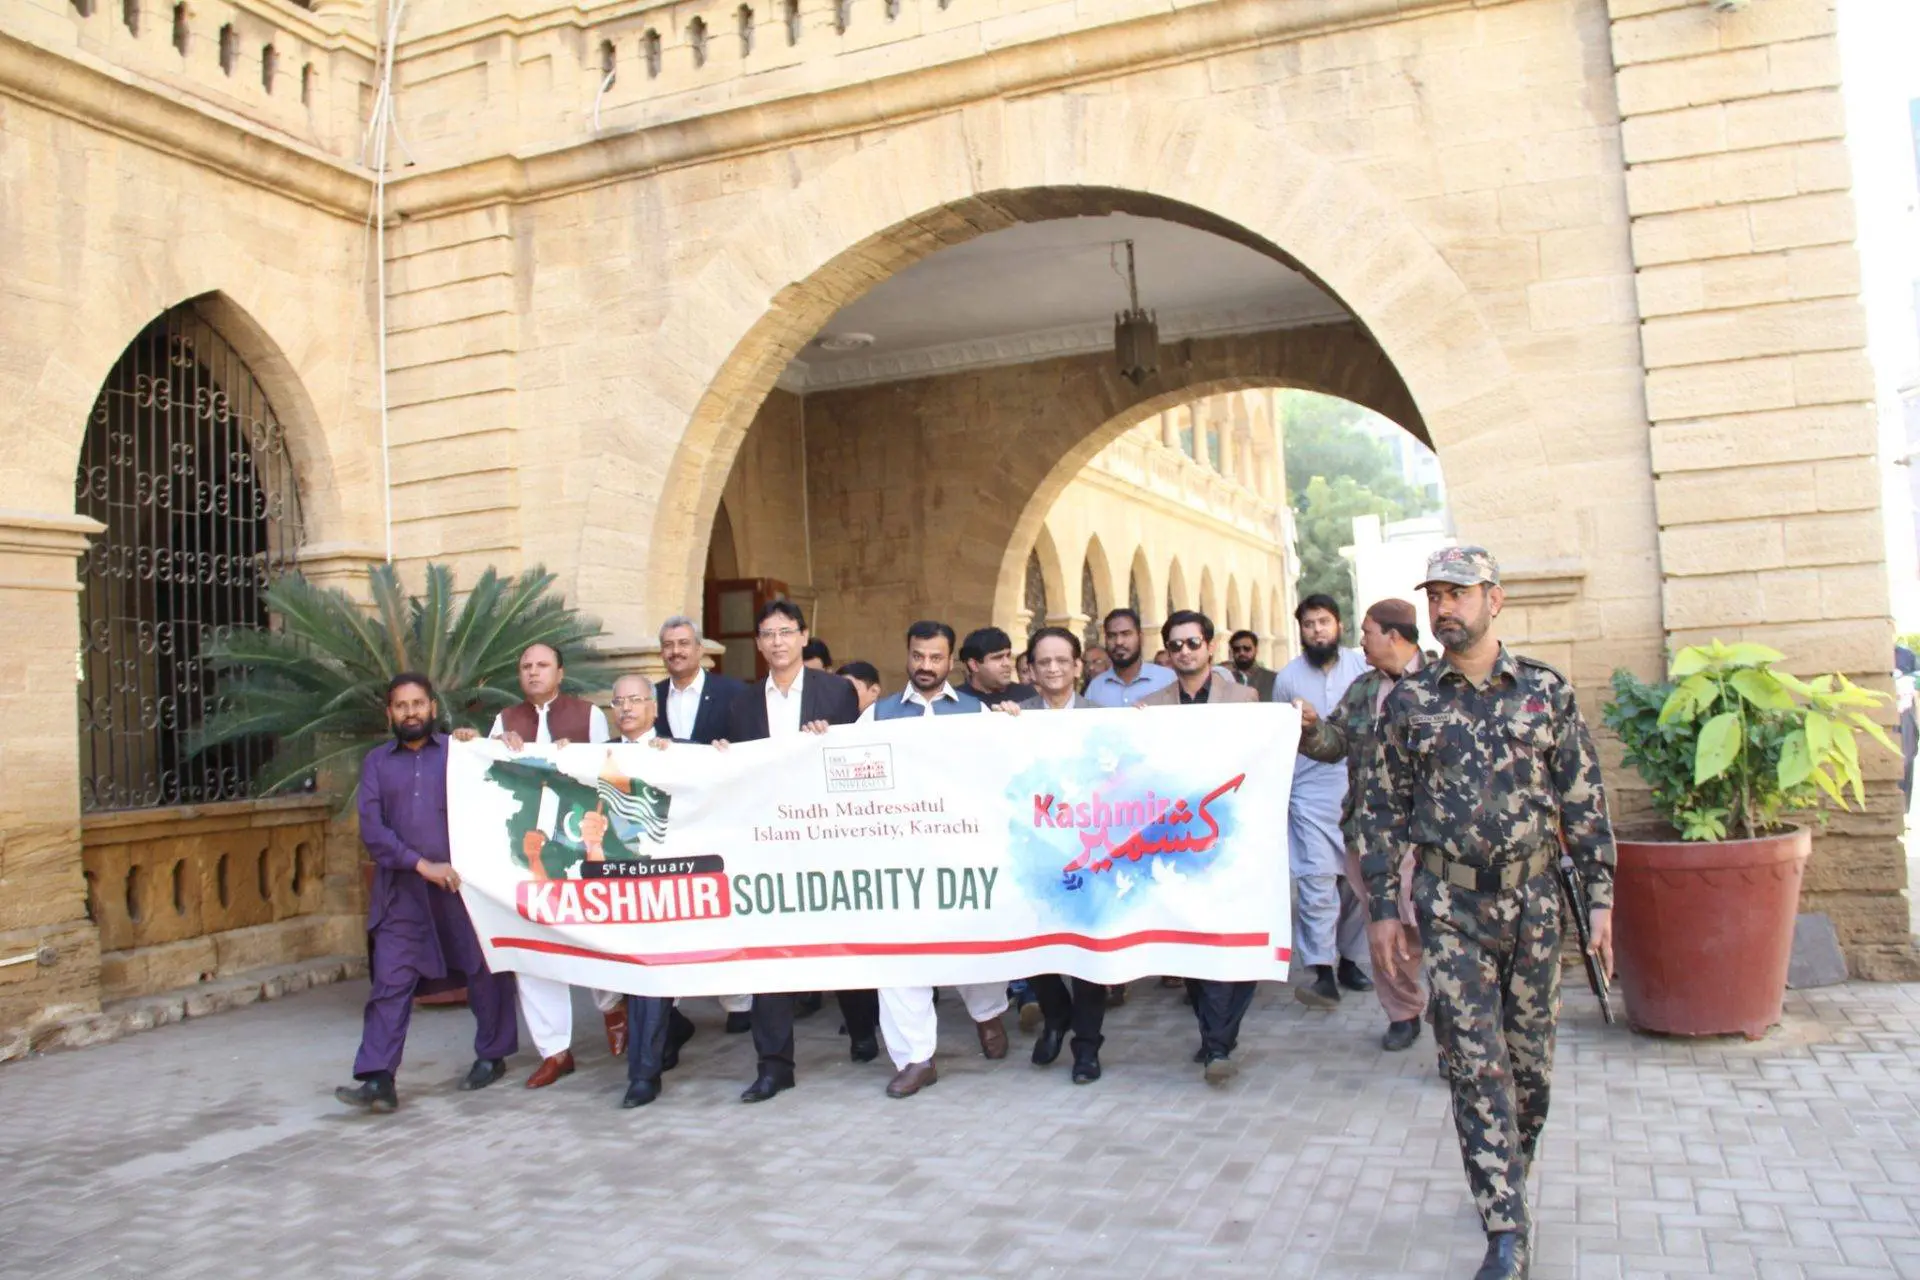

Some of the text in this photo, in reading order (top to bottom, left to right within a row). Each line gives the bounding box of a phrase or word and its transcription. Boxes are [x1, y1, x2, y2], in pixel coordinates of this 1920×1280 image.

[777, 797, 945, 820] Sindh Madressatul
[1034, 791, 1171, 829] Kashmir
[754, 818, 979, 842] Islam University, Karachi
[602, 861, 696, 876] 5th February
[527, 866, 999, 923] KASHMIR SOLIDARITY DAY
